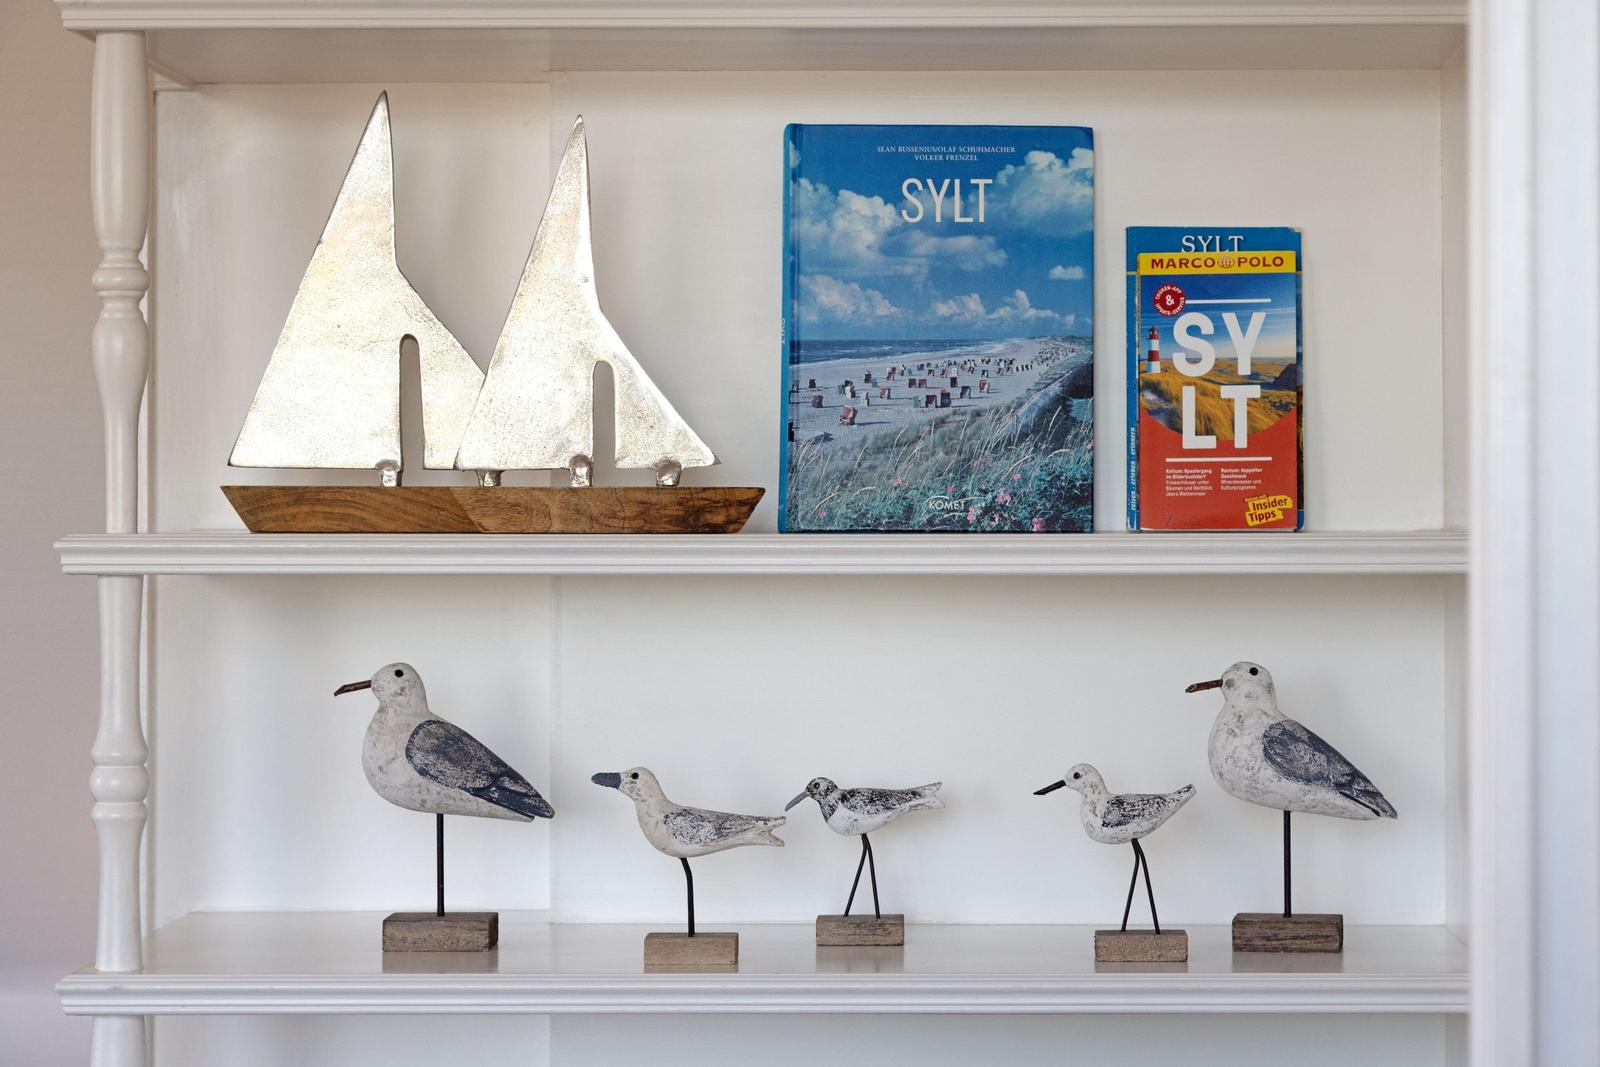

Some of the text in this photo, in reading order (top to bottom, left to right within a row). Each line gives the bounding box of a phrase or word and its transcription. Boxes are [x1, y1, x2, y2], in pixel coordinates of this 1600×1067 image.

[901, 178, 993, 223] SYLT
[1181, 235, 1244, 252] SYLT
[1151, 256, 1284, 269] MARCO POLO
[1165, 294, 1175, 306] &
[1172, 312, 1266, 377] SY
[1182, 384, 1262, 449] LT
[928, 500, 966, 510] KOMET
[1252, 497, 1288, 511] Insider
[1248, 510, 1276, 523] Tipps
